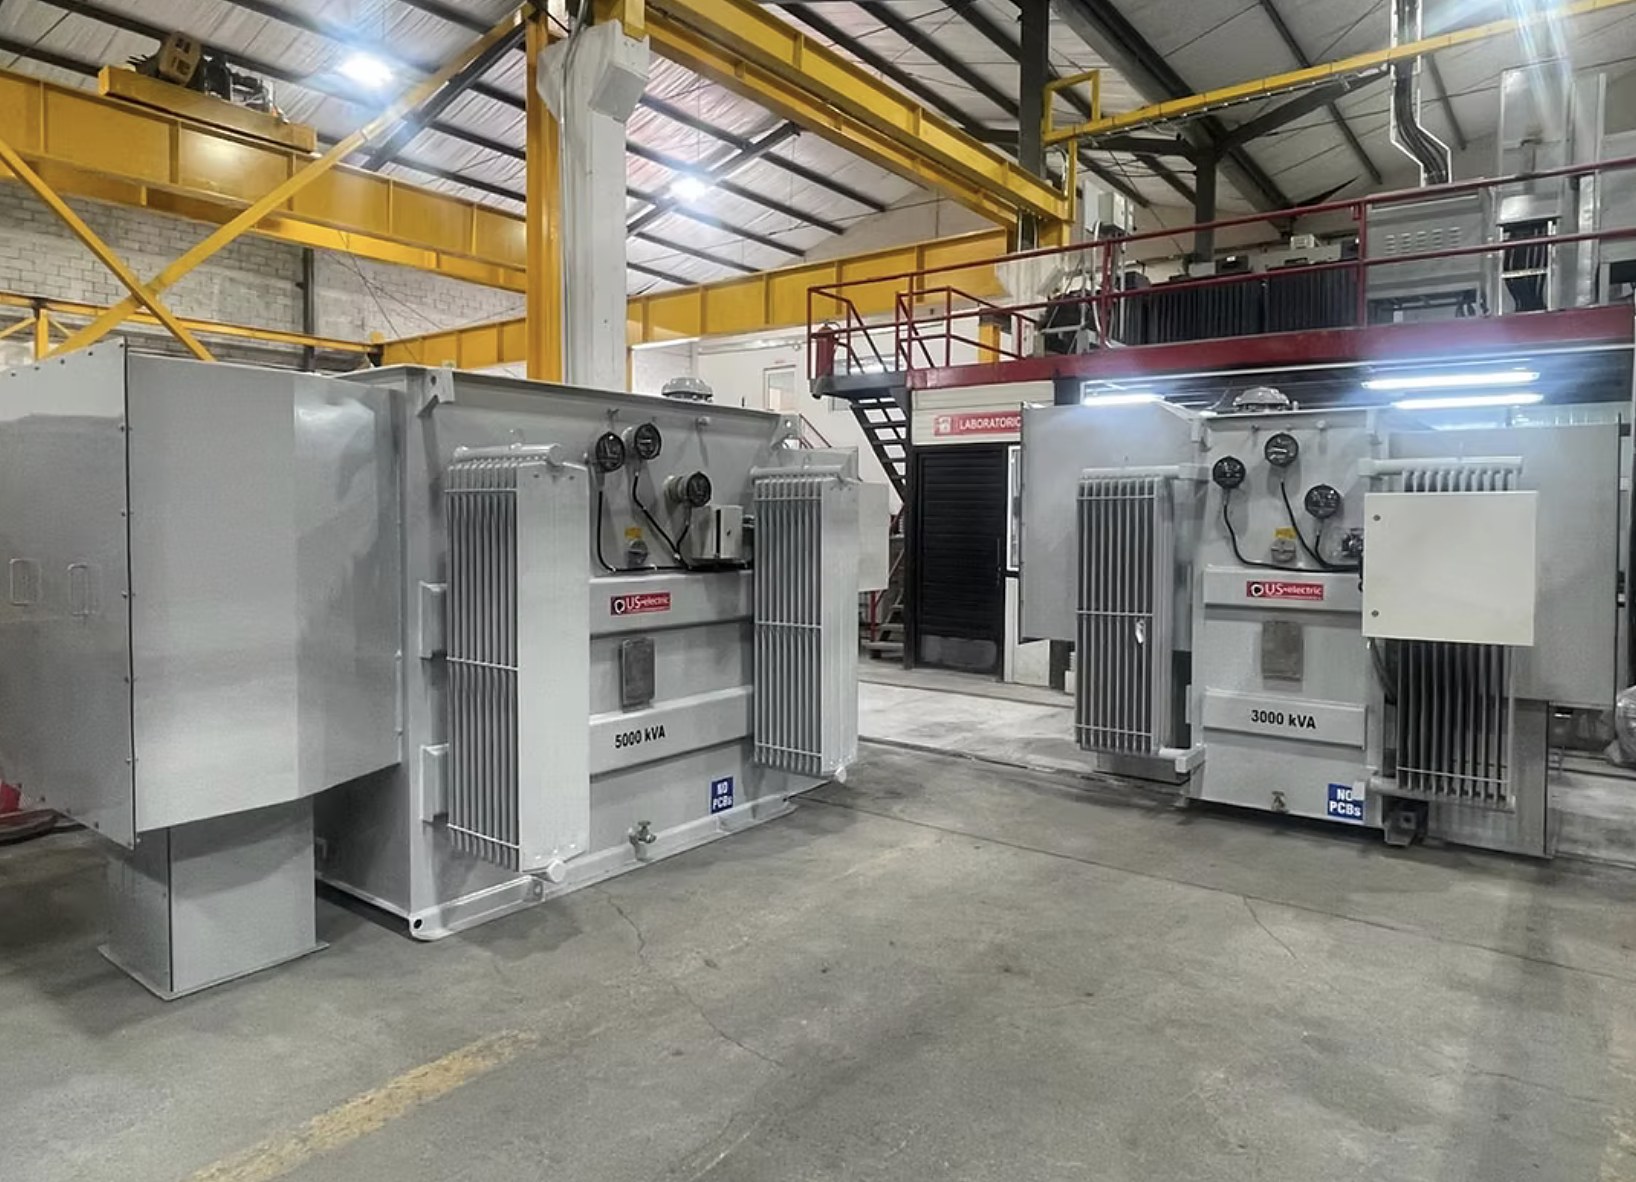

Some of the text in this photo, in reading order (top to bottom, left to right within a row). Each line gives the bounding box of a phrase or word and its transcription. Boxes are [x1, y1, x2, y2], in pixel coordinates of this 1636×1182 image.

[1251, 709, 1316, 729] 3000 kVA
[615, 724, 665, 749] 5000 kVA
[1336, 788, 1353, 801] NO
[1329, 801, 1362, 817] PCBs
